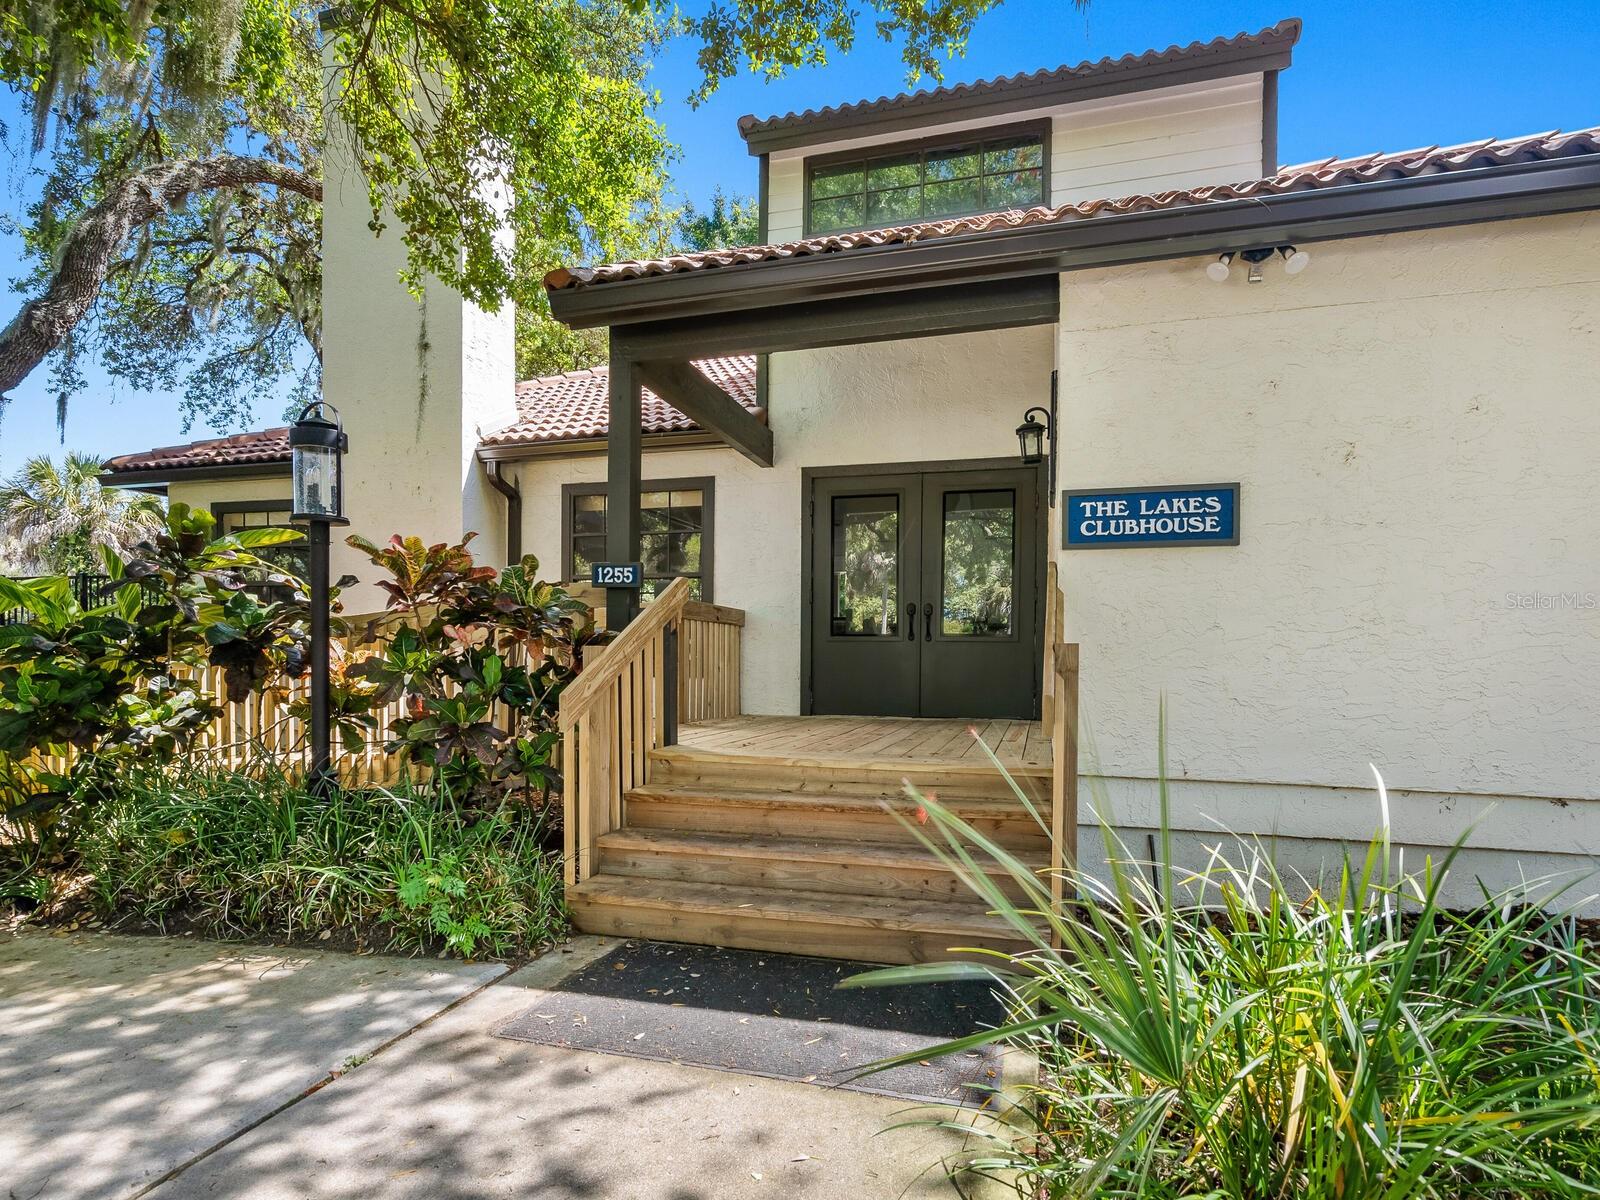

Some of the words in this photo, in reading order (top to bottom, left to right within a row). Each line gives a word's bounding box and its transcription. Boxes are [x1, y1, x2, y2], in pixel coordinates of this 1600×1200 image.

[1080, 500, 1129, 517] THE
[1140, 496, 1222, 515] LAKES
[1080, 516, 1221, 536] CLUBHOUSE
[597, 566, 633, 583] 1255
